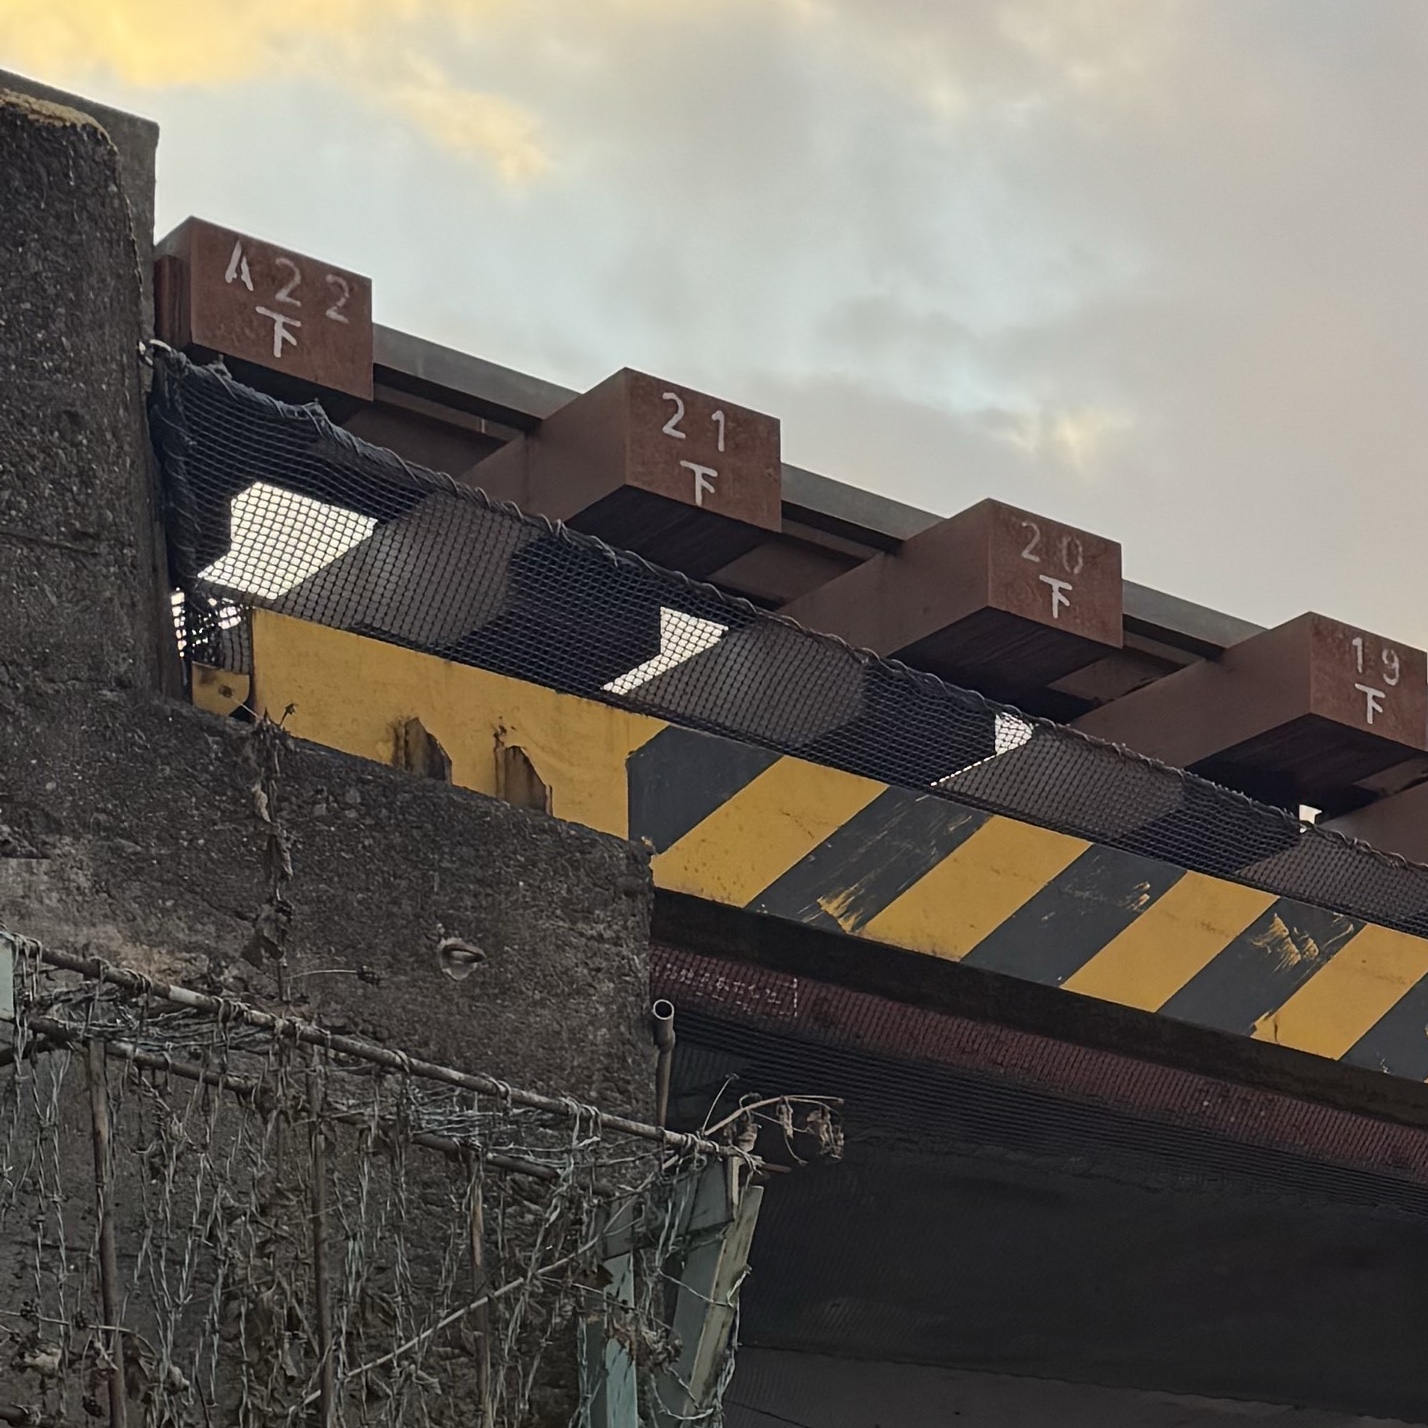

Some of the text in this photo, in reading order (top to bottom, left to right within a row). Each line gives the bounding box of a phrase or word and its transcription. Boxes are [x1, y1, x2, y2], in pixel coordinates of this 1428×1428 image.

[255, 306, 302, 358] 下
[661, 391, 726, 453] 21
[679, 459, 718, 507] 下
[1020, 520, 1084, 575] 20
[1038, 574, 1073, 619] 下
[1351, 636, 1401, 687] 19
[1354, 682, 1387, 725] 下
